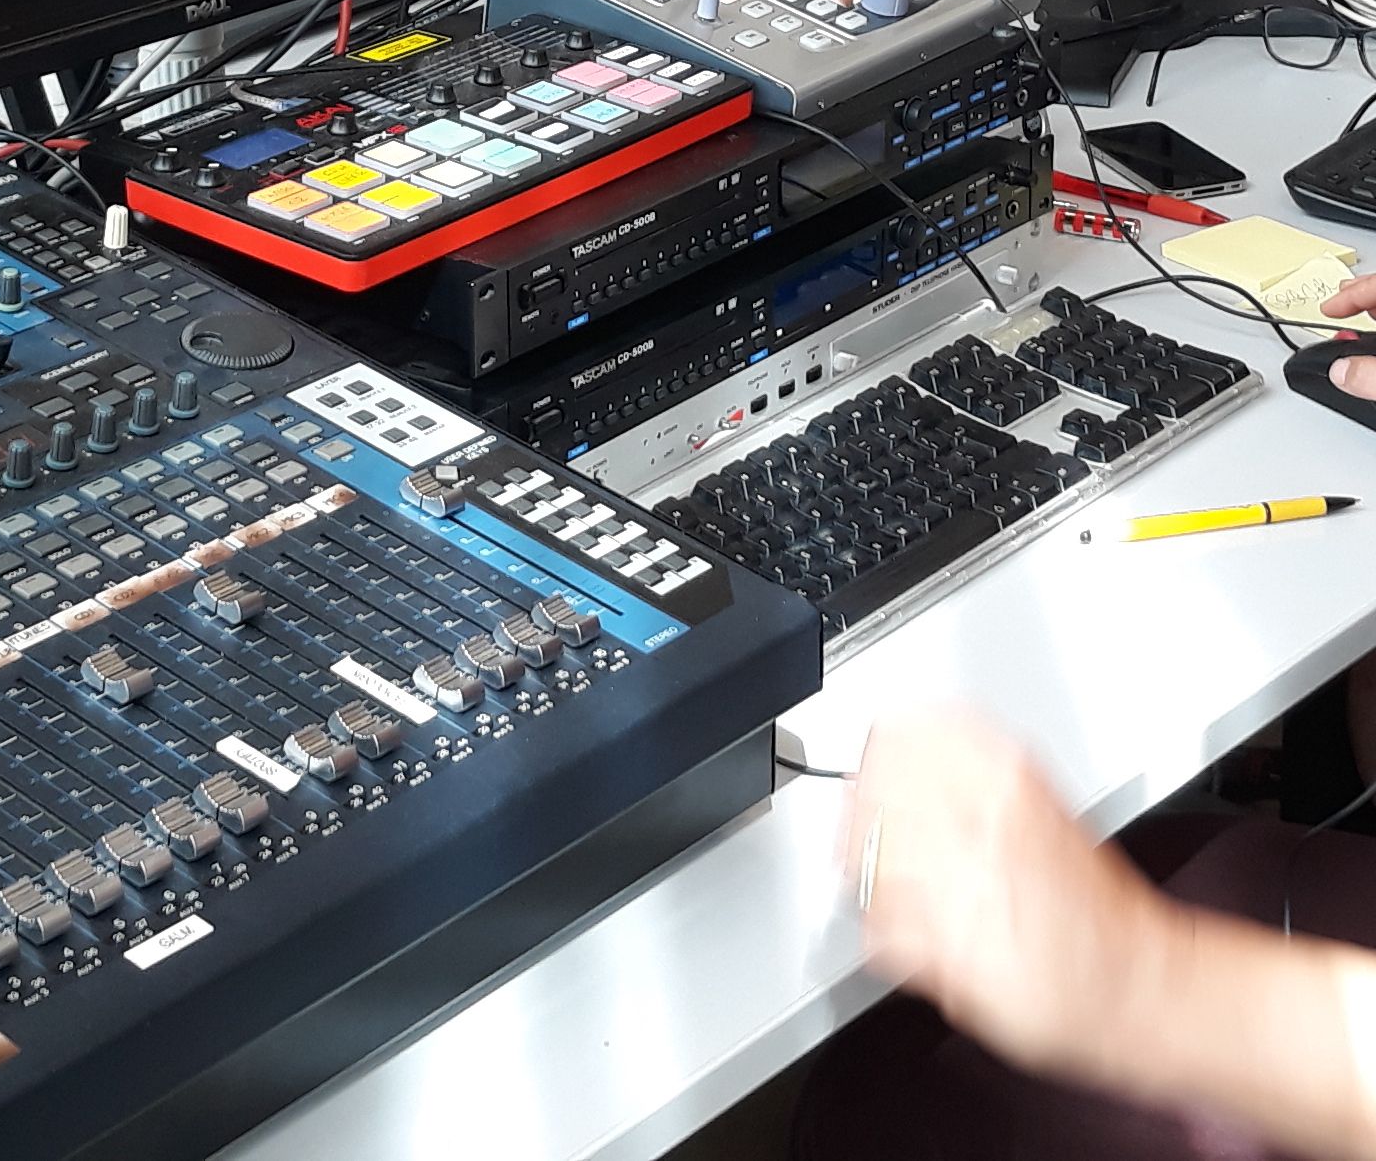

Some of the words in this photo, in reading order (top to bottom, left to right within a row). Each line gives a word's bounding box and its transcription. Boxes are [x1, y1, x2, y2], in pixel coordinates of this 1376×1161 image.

[571, 230, 617, 259] TASCAM
[617, 211, 657, 236] CD-500B
[872, 294, 901, 314] STUDER
[571, 359, 617, 388] TASCAM
[617, 340, 655, 365] CD-500B
